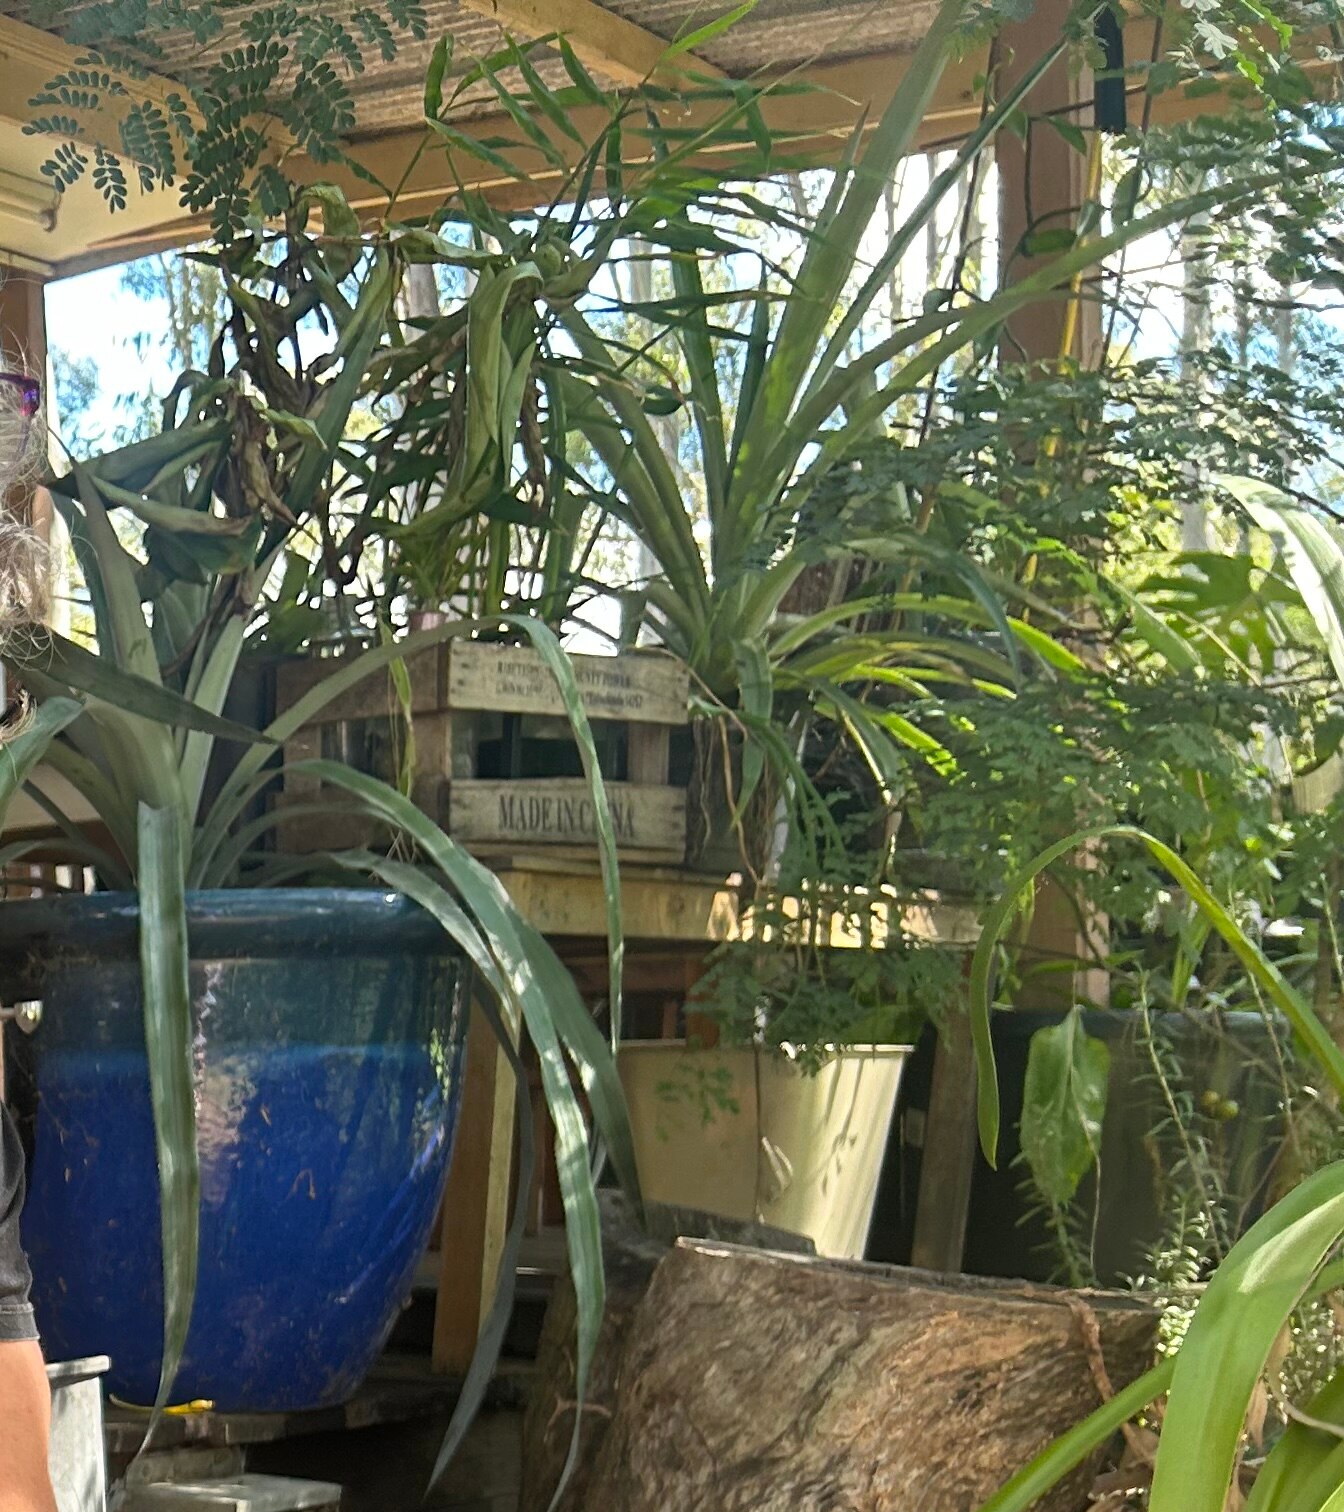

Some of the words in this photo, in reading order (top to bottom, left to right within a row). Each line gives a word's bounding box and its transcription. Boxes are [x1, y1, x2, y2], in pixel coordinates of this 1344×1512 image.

[498, 794, 553, 833] MADE
[556, 797, 576, 834] IN
[578, 798, 635, 838] CNA
